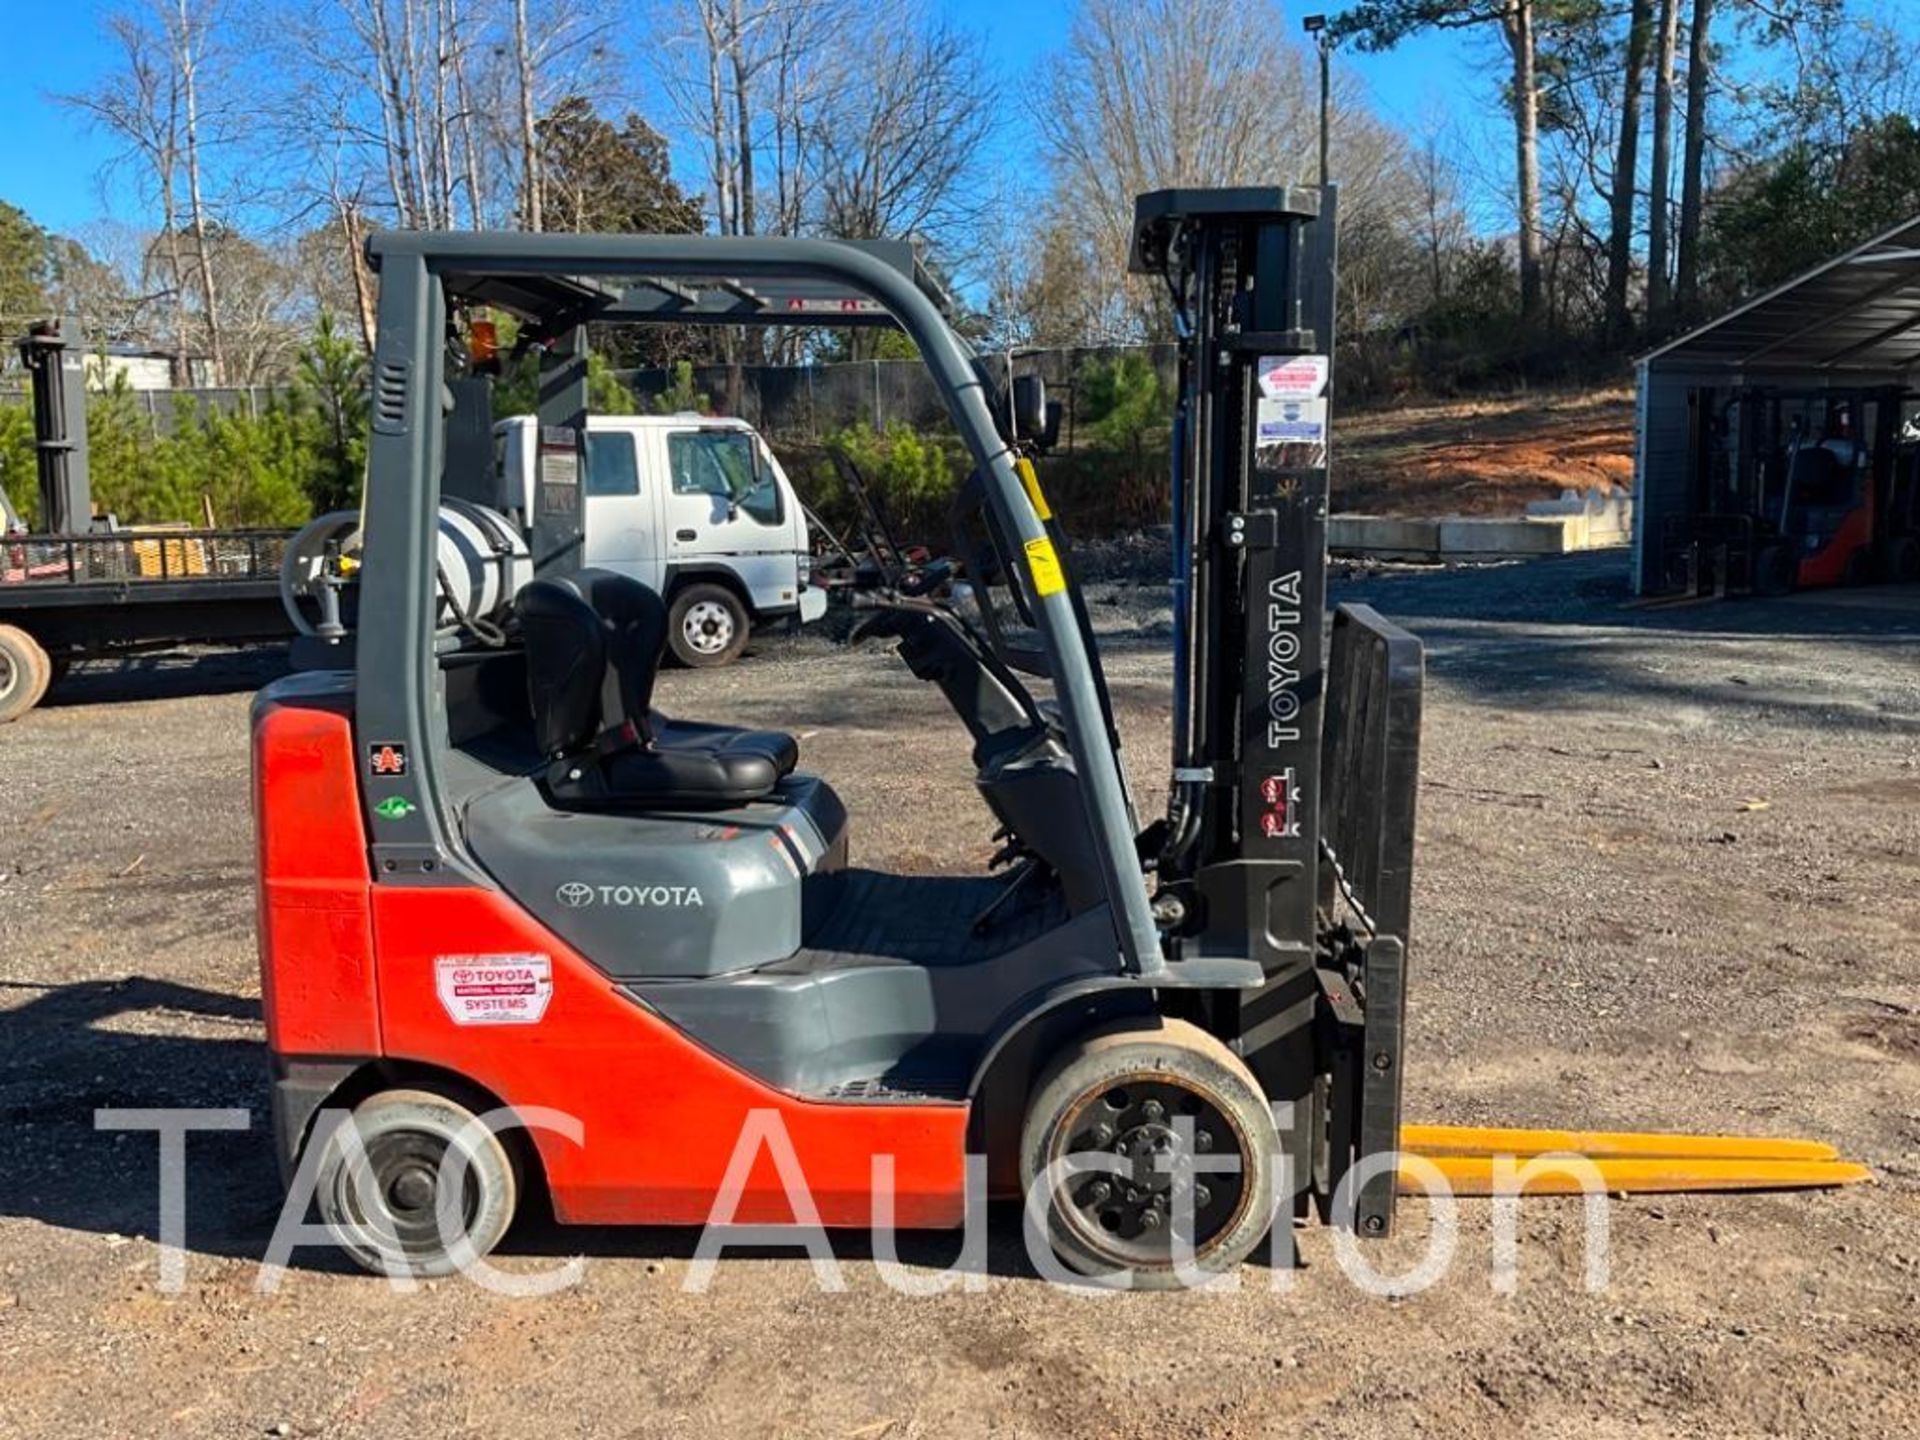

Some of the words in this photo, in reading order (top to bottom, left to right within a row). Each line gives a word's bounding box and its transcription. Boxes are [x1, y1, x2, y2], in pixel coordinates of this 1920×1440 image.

[1268, 570, 1301, 748] TOYOTA
[598, 885, 704, 906] TOYOTA
[476, 969, 535, 982] TOYOTA
[464, 998, 528, 1010] SYSTEMS
